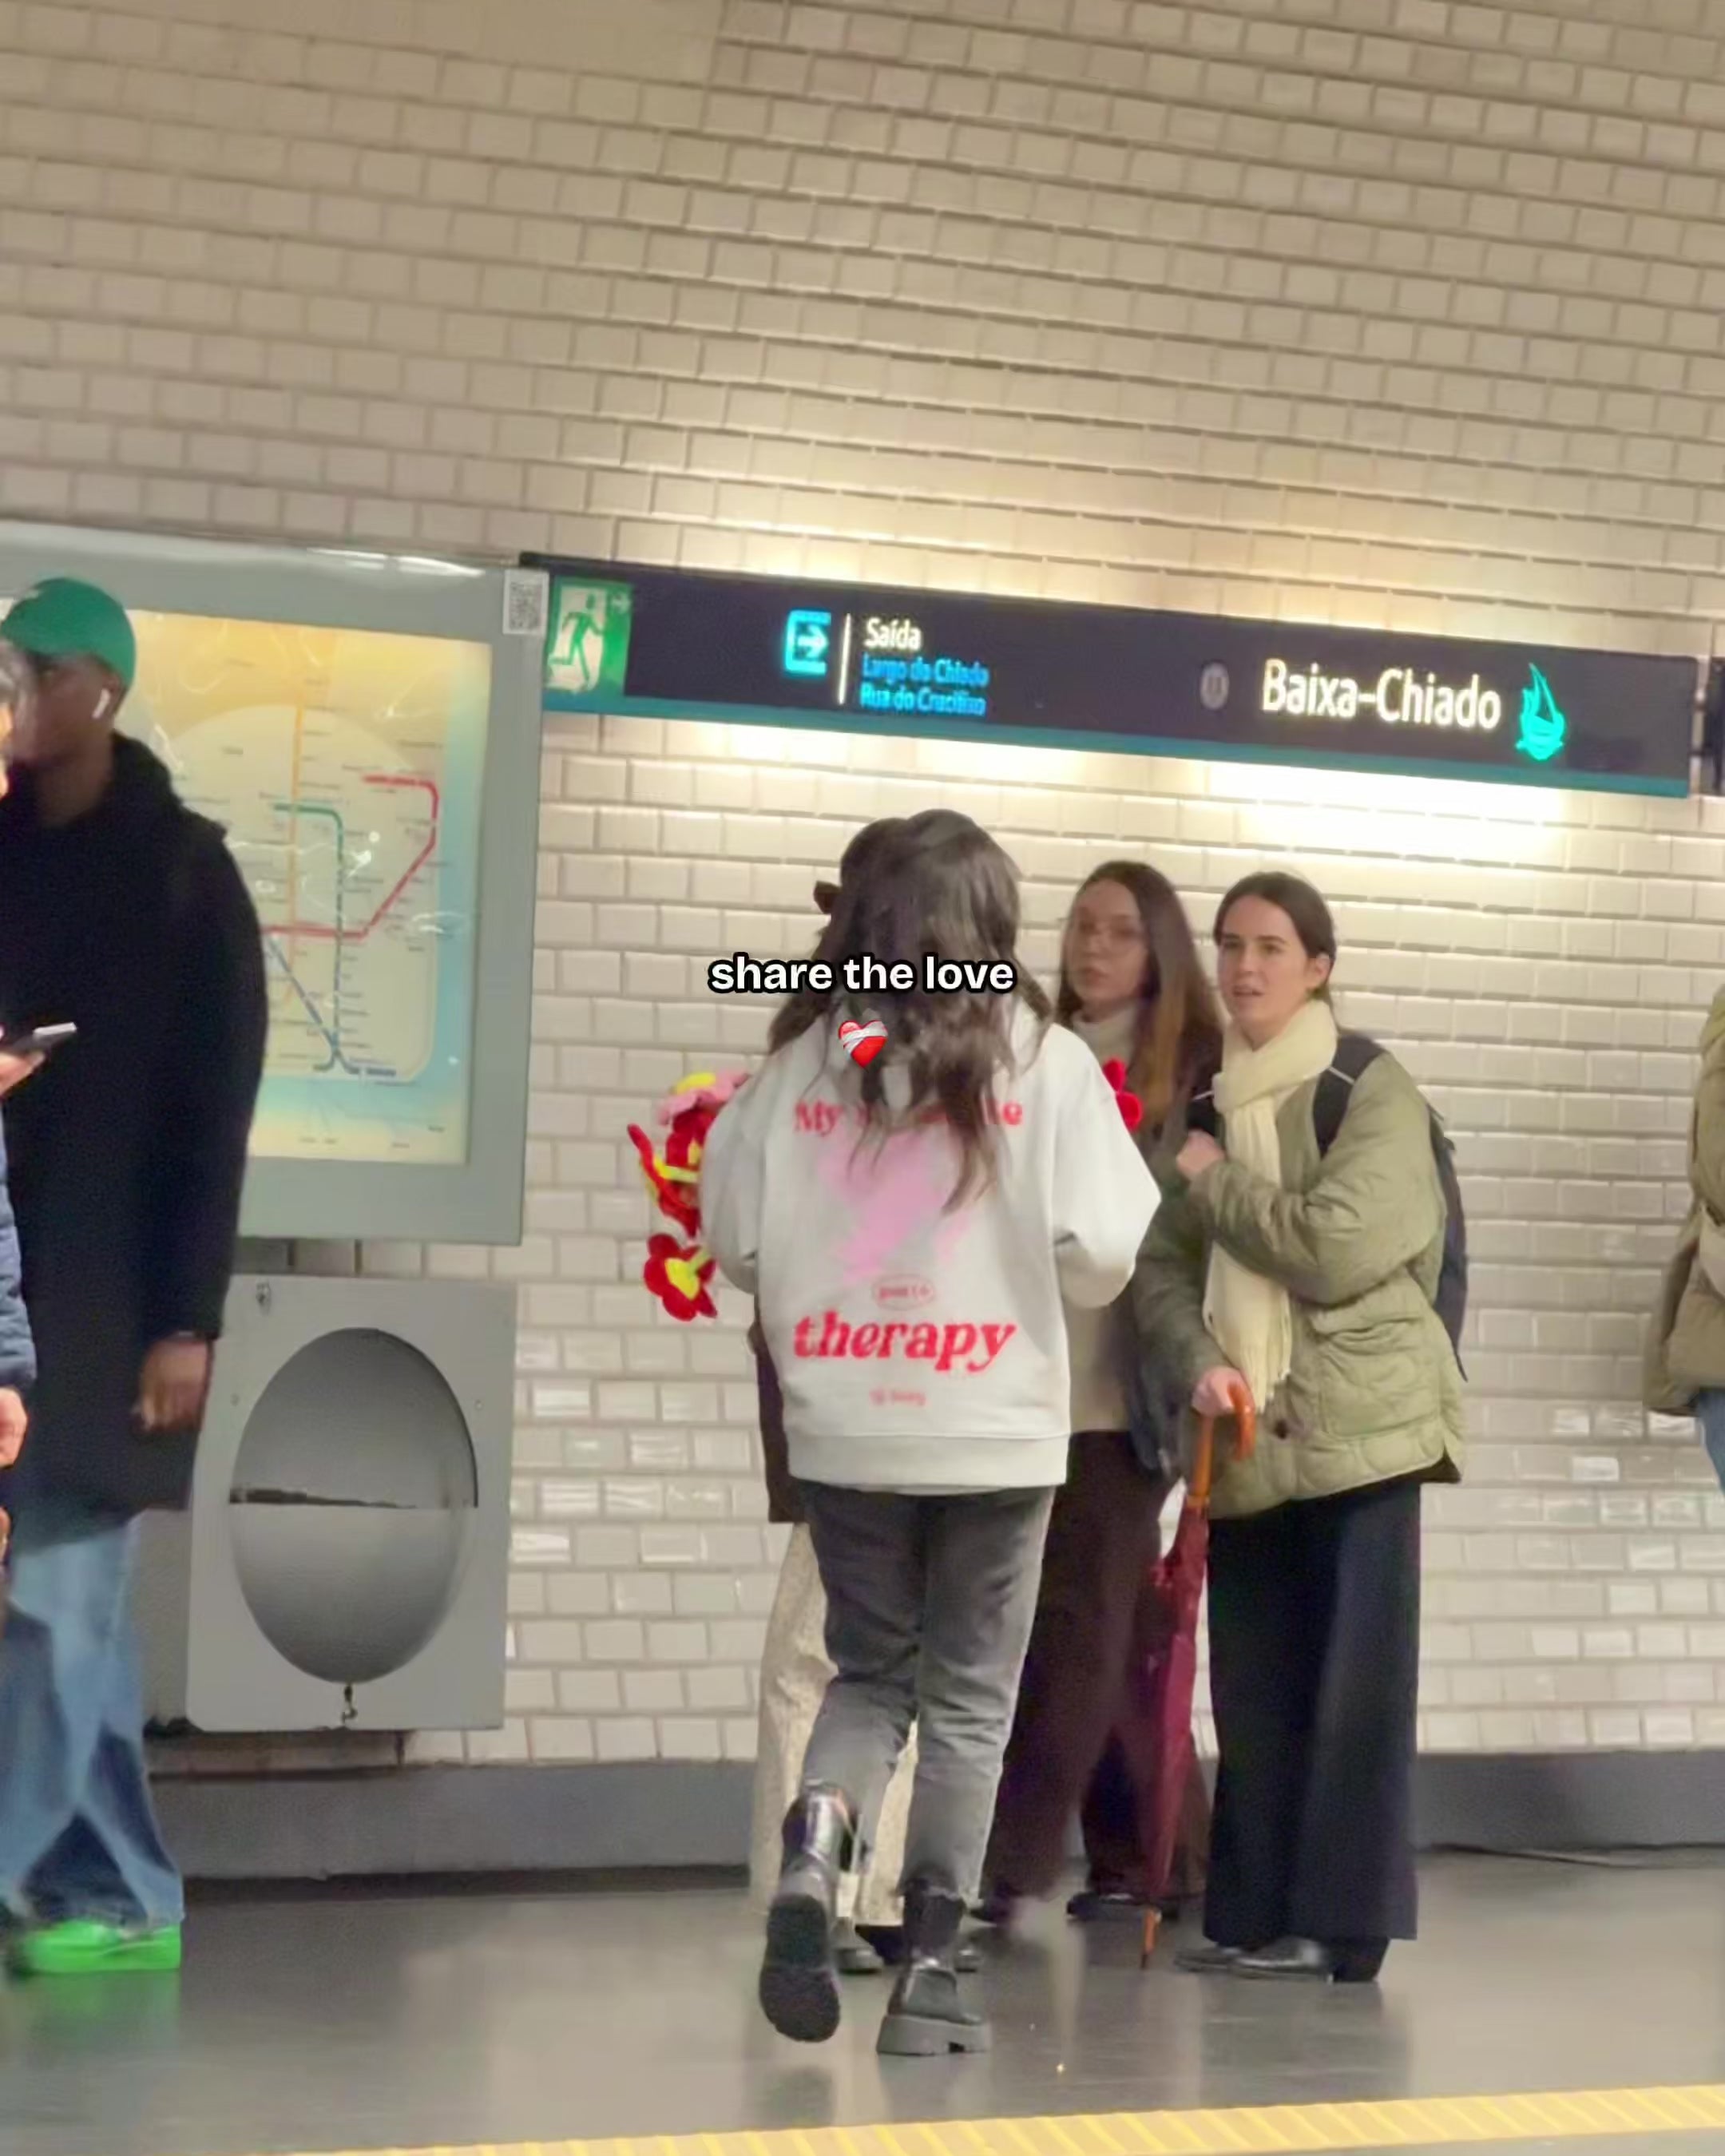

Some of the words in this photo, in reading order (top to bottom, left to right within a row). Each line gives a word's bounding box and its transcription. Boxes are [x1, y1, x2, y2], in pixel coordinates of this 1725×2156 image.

[864, 616, 922, 651] Saída
[861, 682, 891, 708] Rua
[894, 685, 915, 711] do
[1263, 657, 1501, 729] Baixa-Chiado
[794, 1100, 843, 1137] My
[793, 1310, 1017, 1373] therapy
